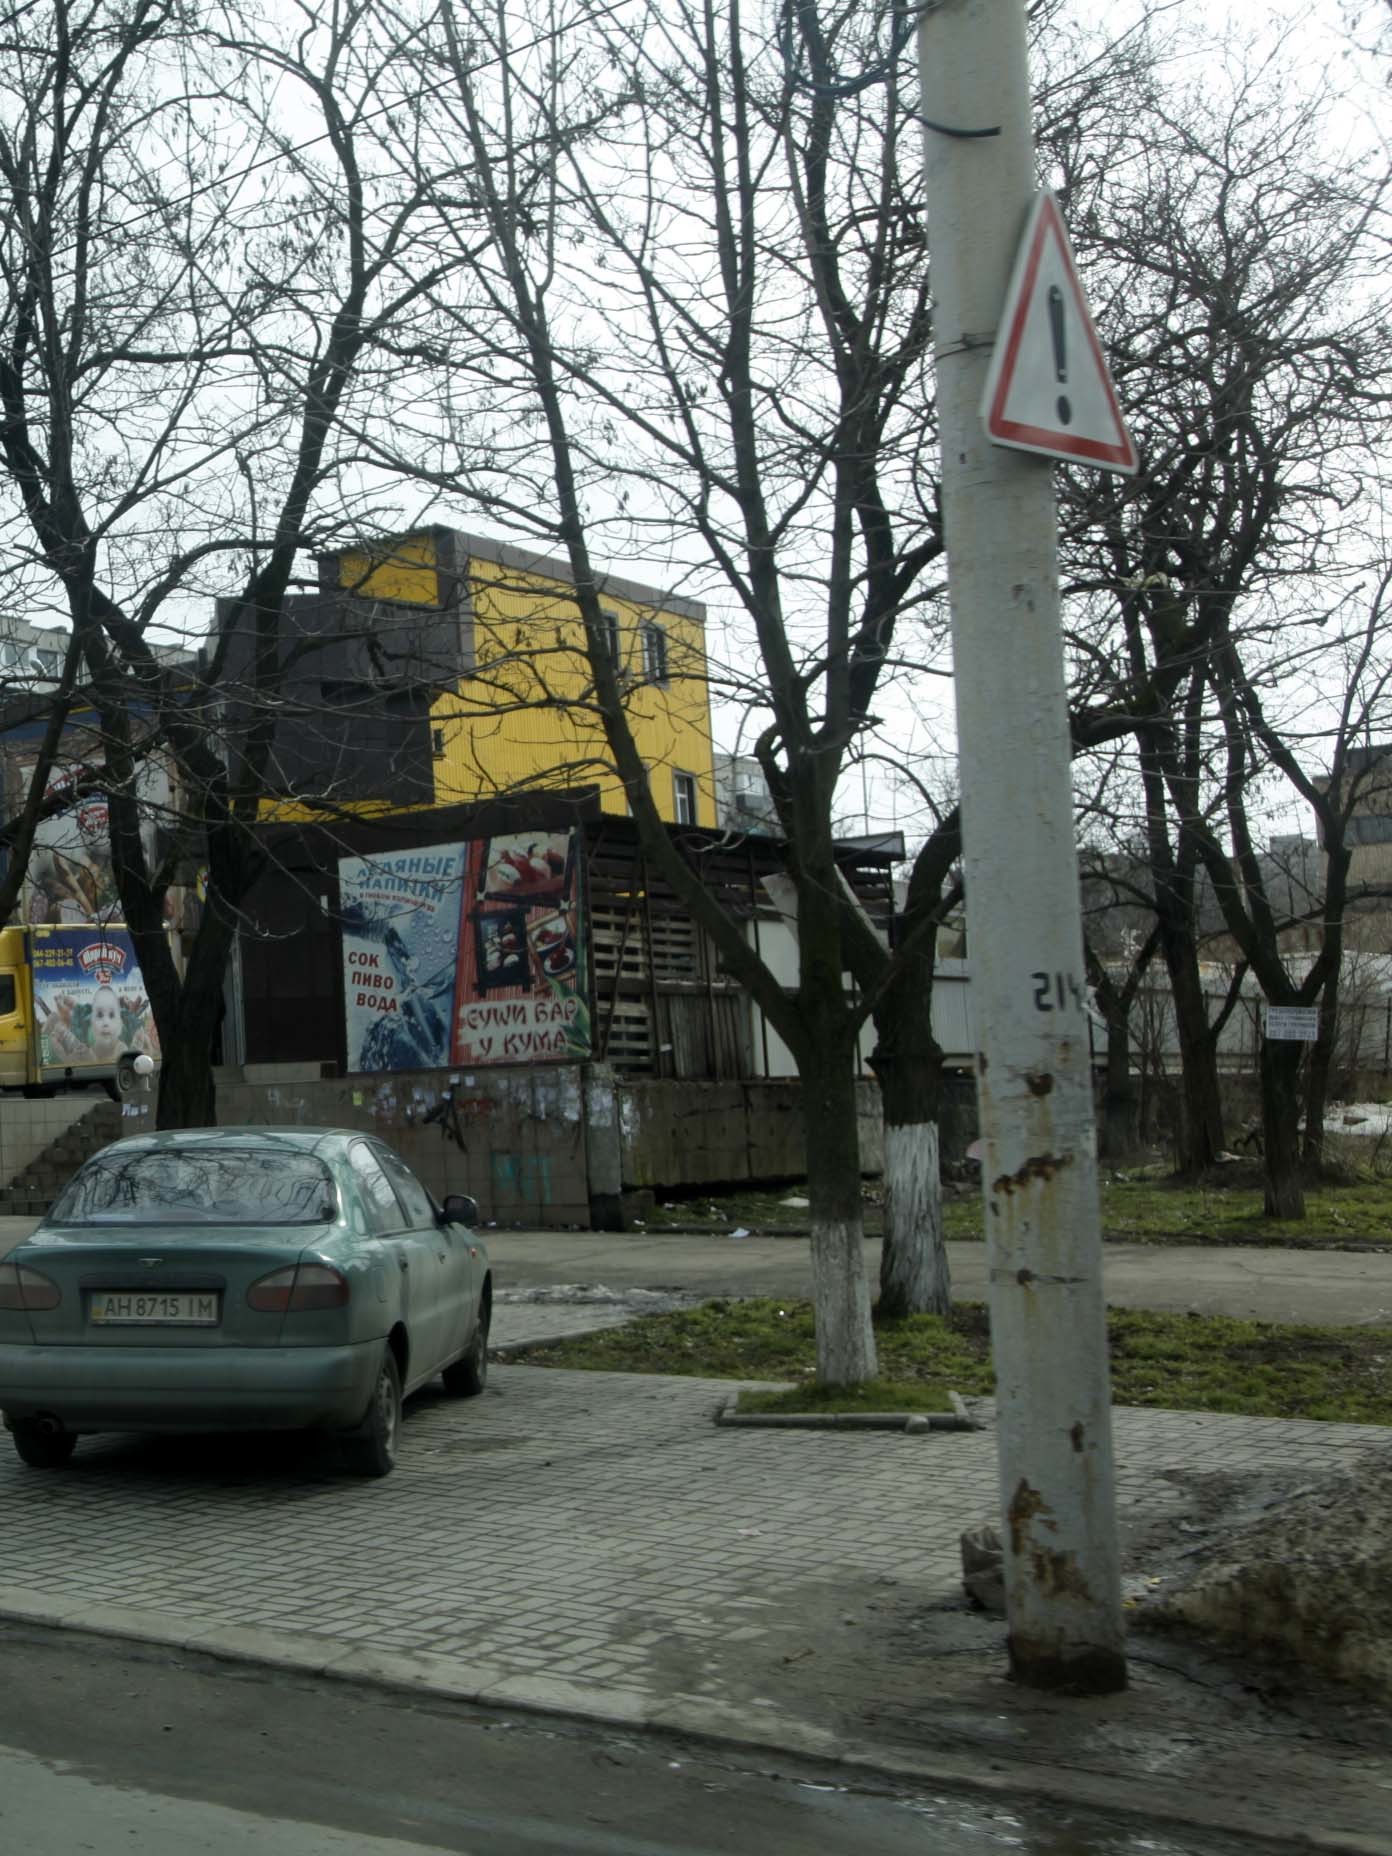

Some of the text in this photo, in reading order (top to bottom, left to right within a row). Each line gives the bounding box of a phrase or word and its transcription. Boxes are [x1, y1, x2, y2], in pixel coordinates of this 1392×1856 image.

[348, 951, 379, 968] СОК
[352, 971, 394, 990] ПИВО
[356, 992, 397, 1012] ВОДА
[467, 999, 577, 1029] СУШИ БАР
[480, 1029, 567, 1057] У КУМА
[104, 1298, 212, 1318] AH 8715 IM
